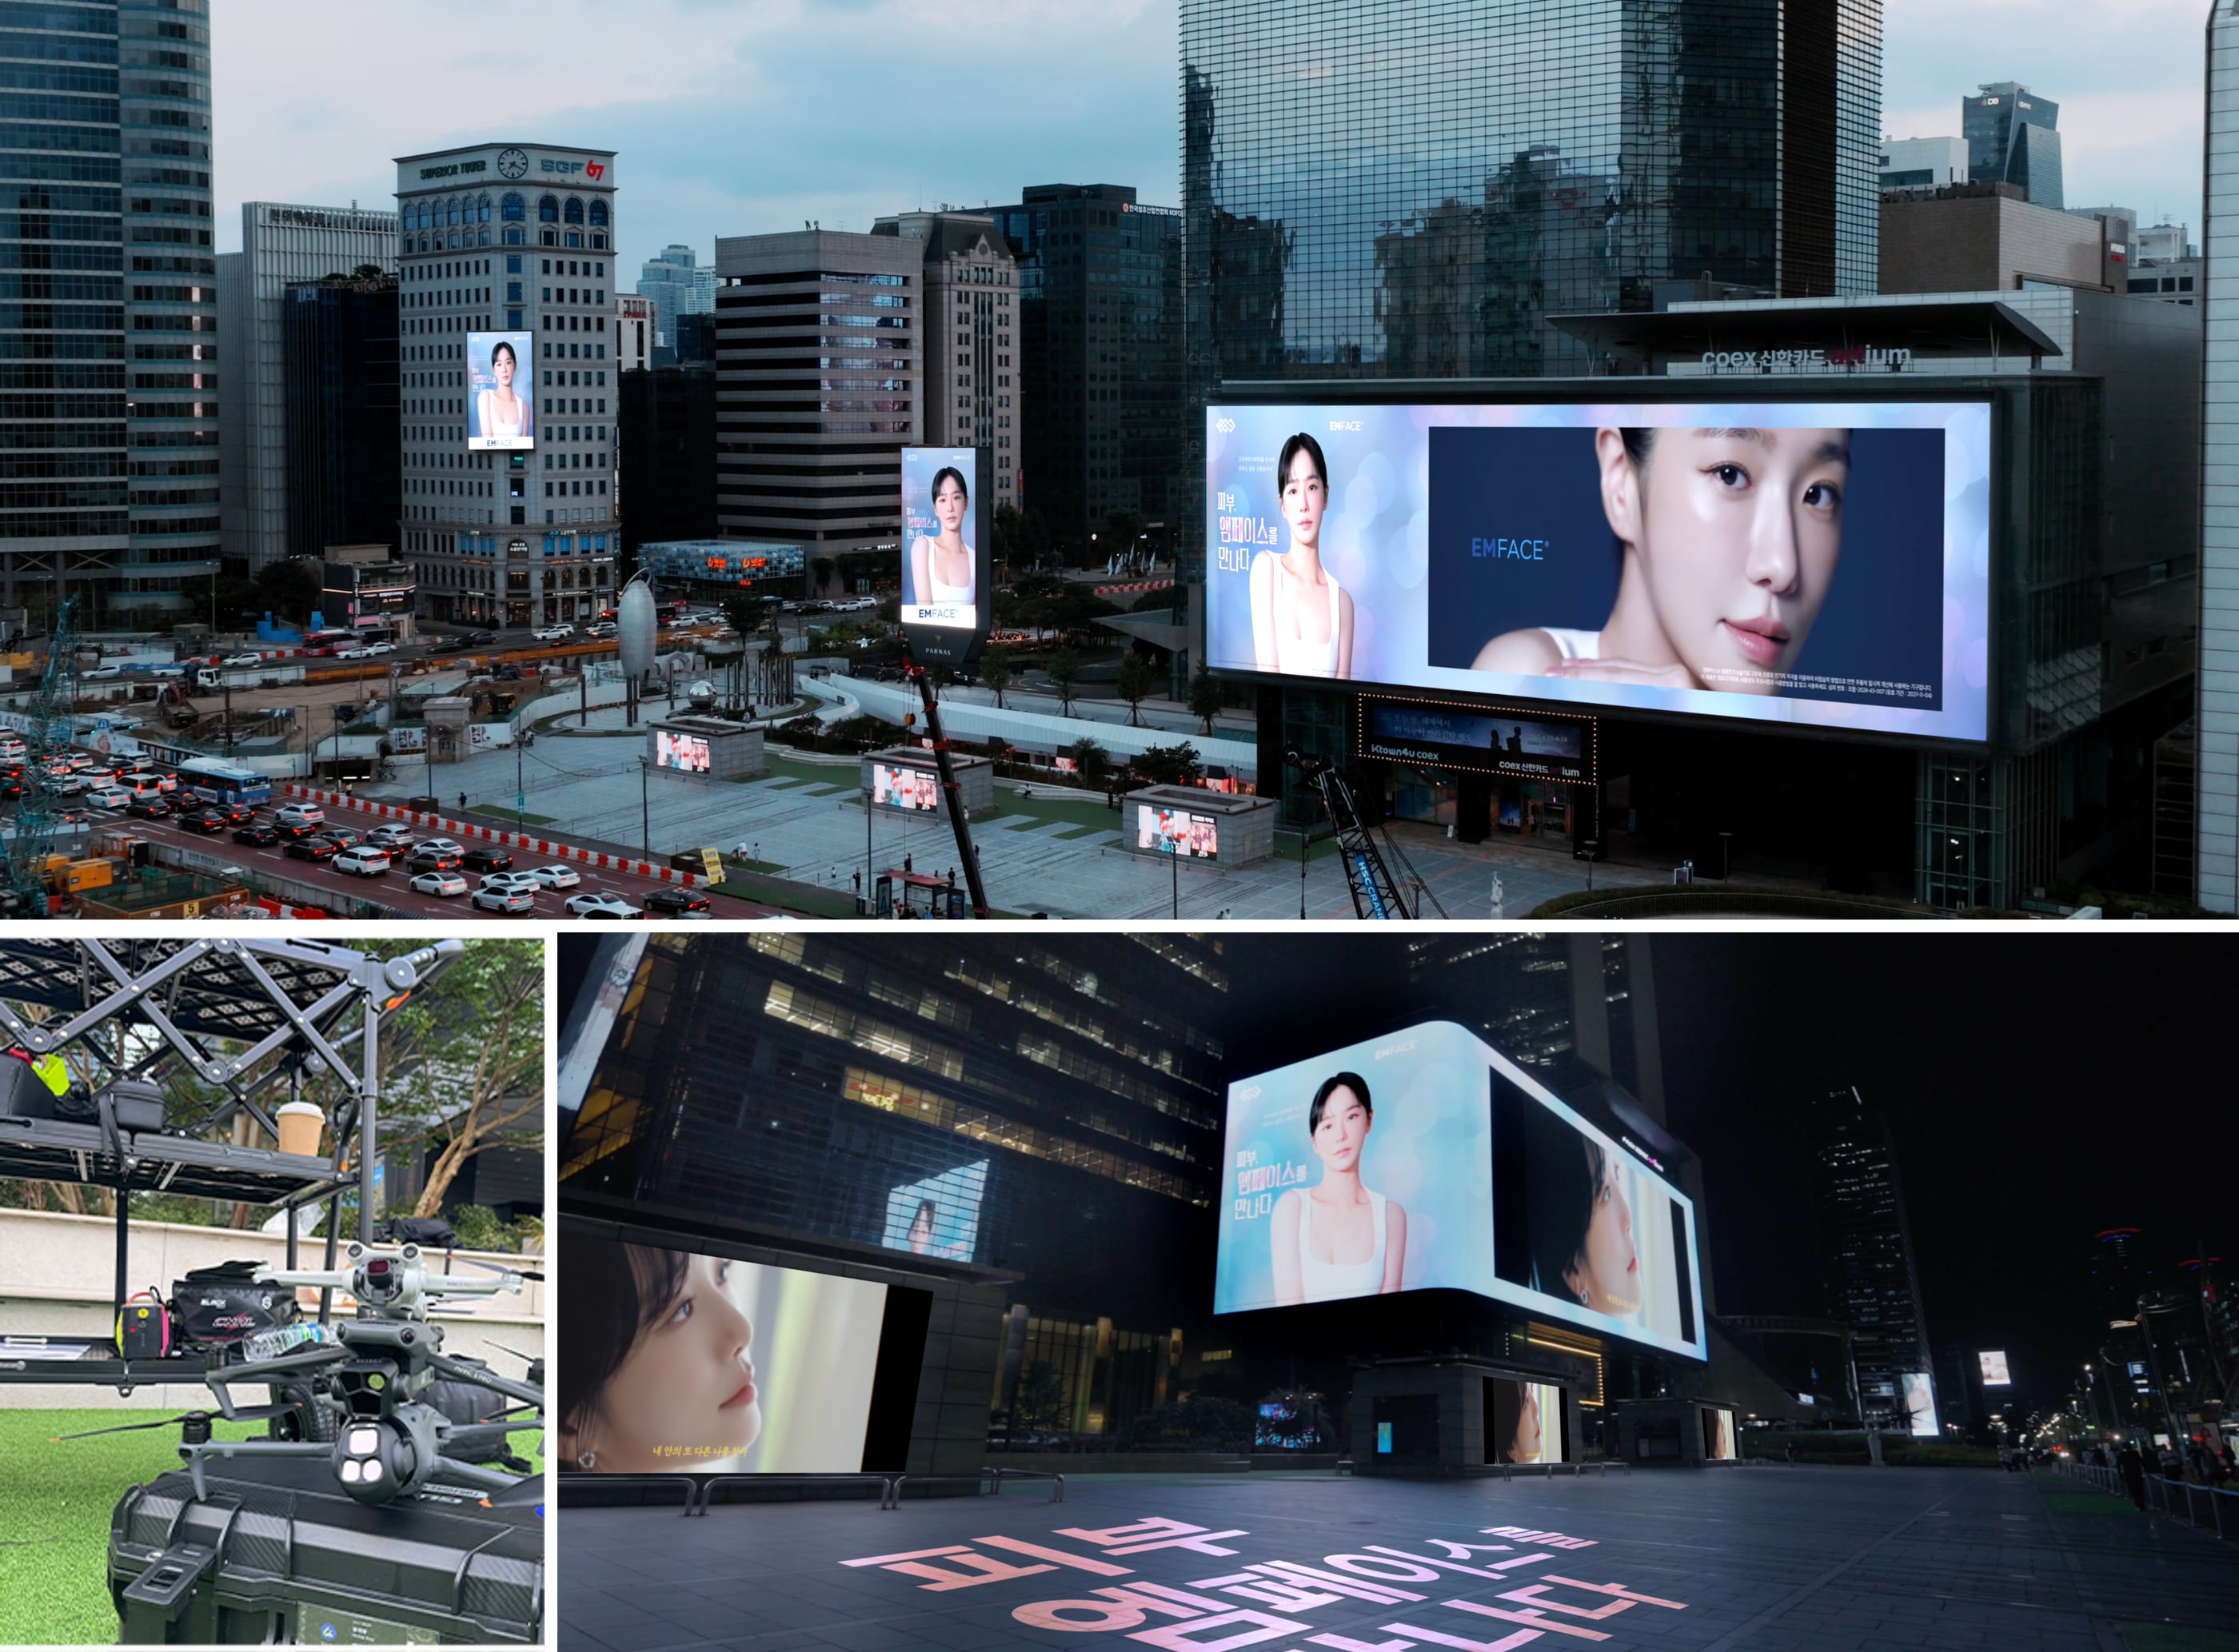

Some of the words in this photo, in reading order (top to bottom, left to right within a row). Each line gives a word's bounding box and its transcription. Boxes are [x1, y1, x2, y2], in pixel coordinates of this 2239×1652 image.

[420, 164, 458, 180] SUPERIOR
[461, 160, 486, 174] TOWER
[1702, 351, 1757, 367] coex
[1760, 349, 1825, 367] 신한카드
[1830, 344, 1911, 365] artium
[1330, 421, 1362, 431] EMFACE
[1219, 516, 1278, 545] 엠페이스를
[1218, 547, 1250, 573] 만나다
[1472, 537, 1544, 560] EMFACE
[919, 609, 956, 618] EMFACE
[1417, 751, 1439, 760] coex
[1499, 760, 1521, 770] coex
[1522, 762, 1549, 774] 신한카드
[1359, 862, 1372, 885] HSC
[188, 904, 194, 913] 5
[1375, 1041, 1416, 1060] EMFACE
[1238, 1160, 1307, 1195] 엠페이스를
[1235, 1193, 1273, 1221] 만나다
[653, 1445, 662, 1457] 내
[665, 1445, 681, 1457] 안의
[694, 1445, 711, 1458] 다른
[838, 1516, 1251, 1592] 피부
[1012, 1526, 1599, 1652] 엠페이스를
